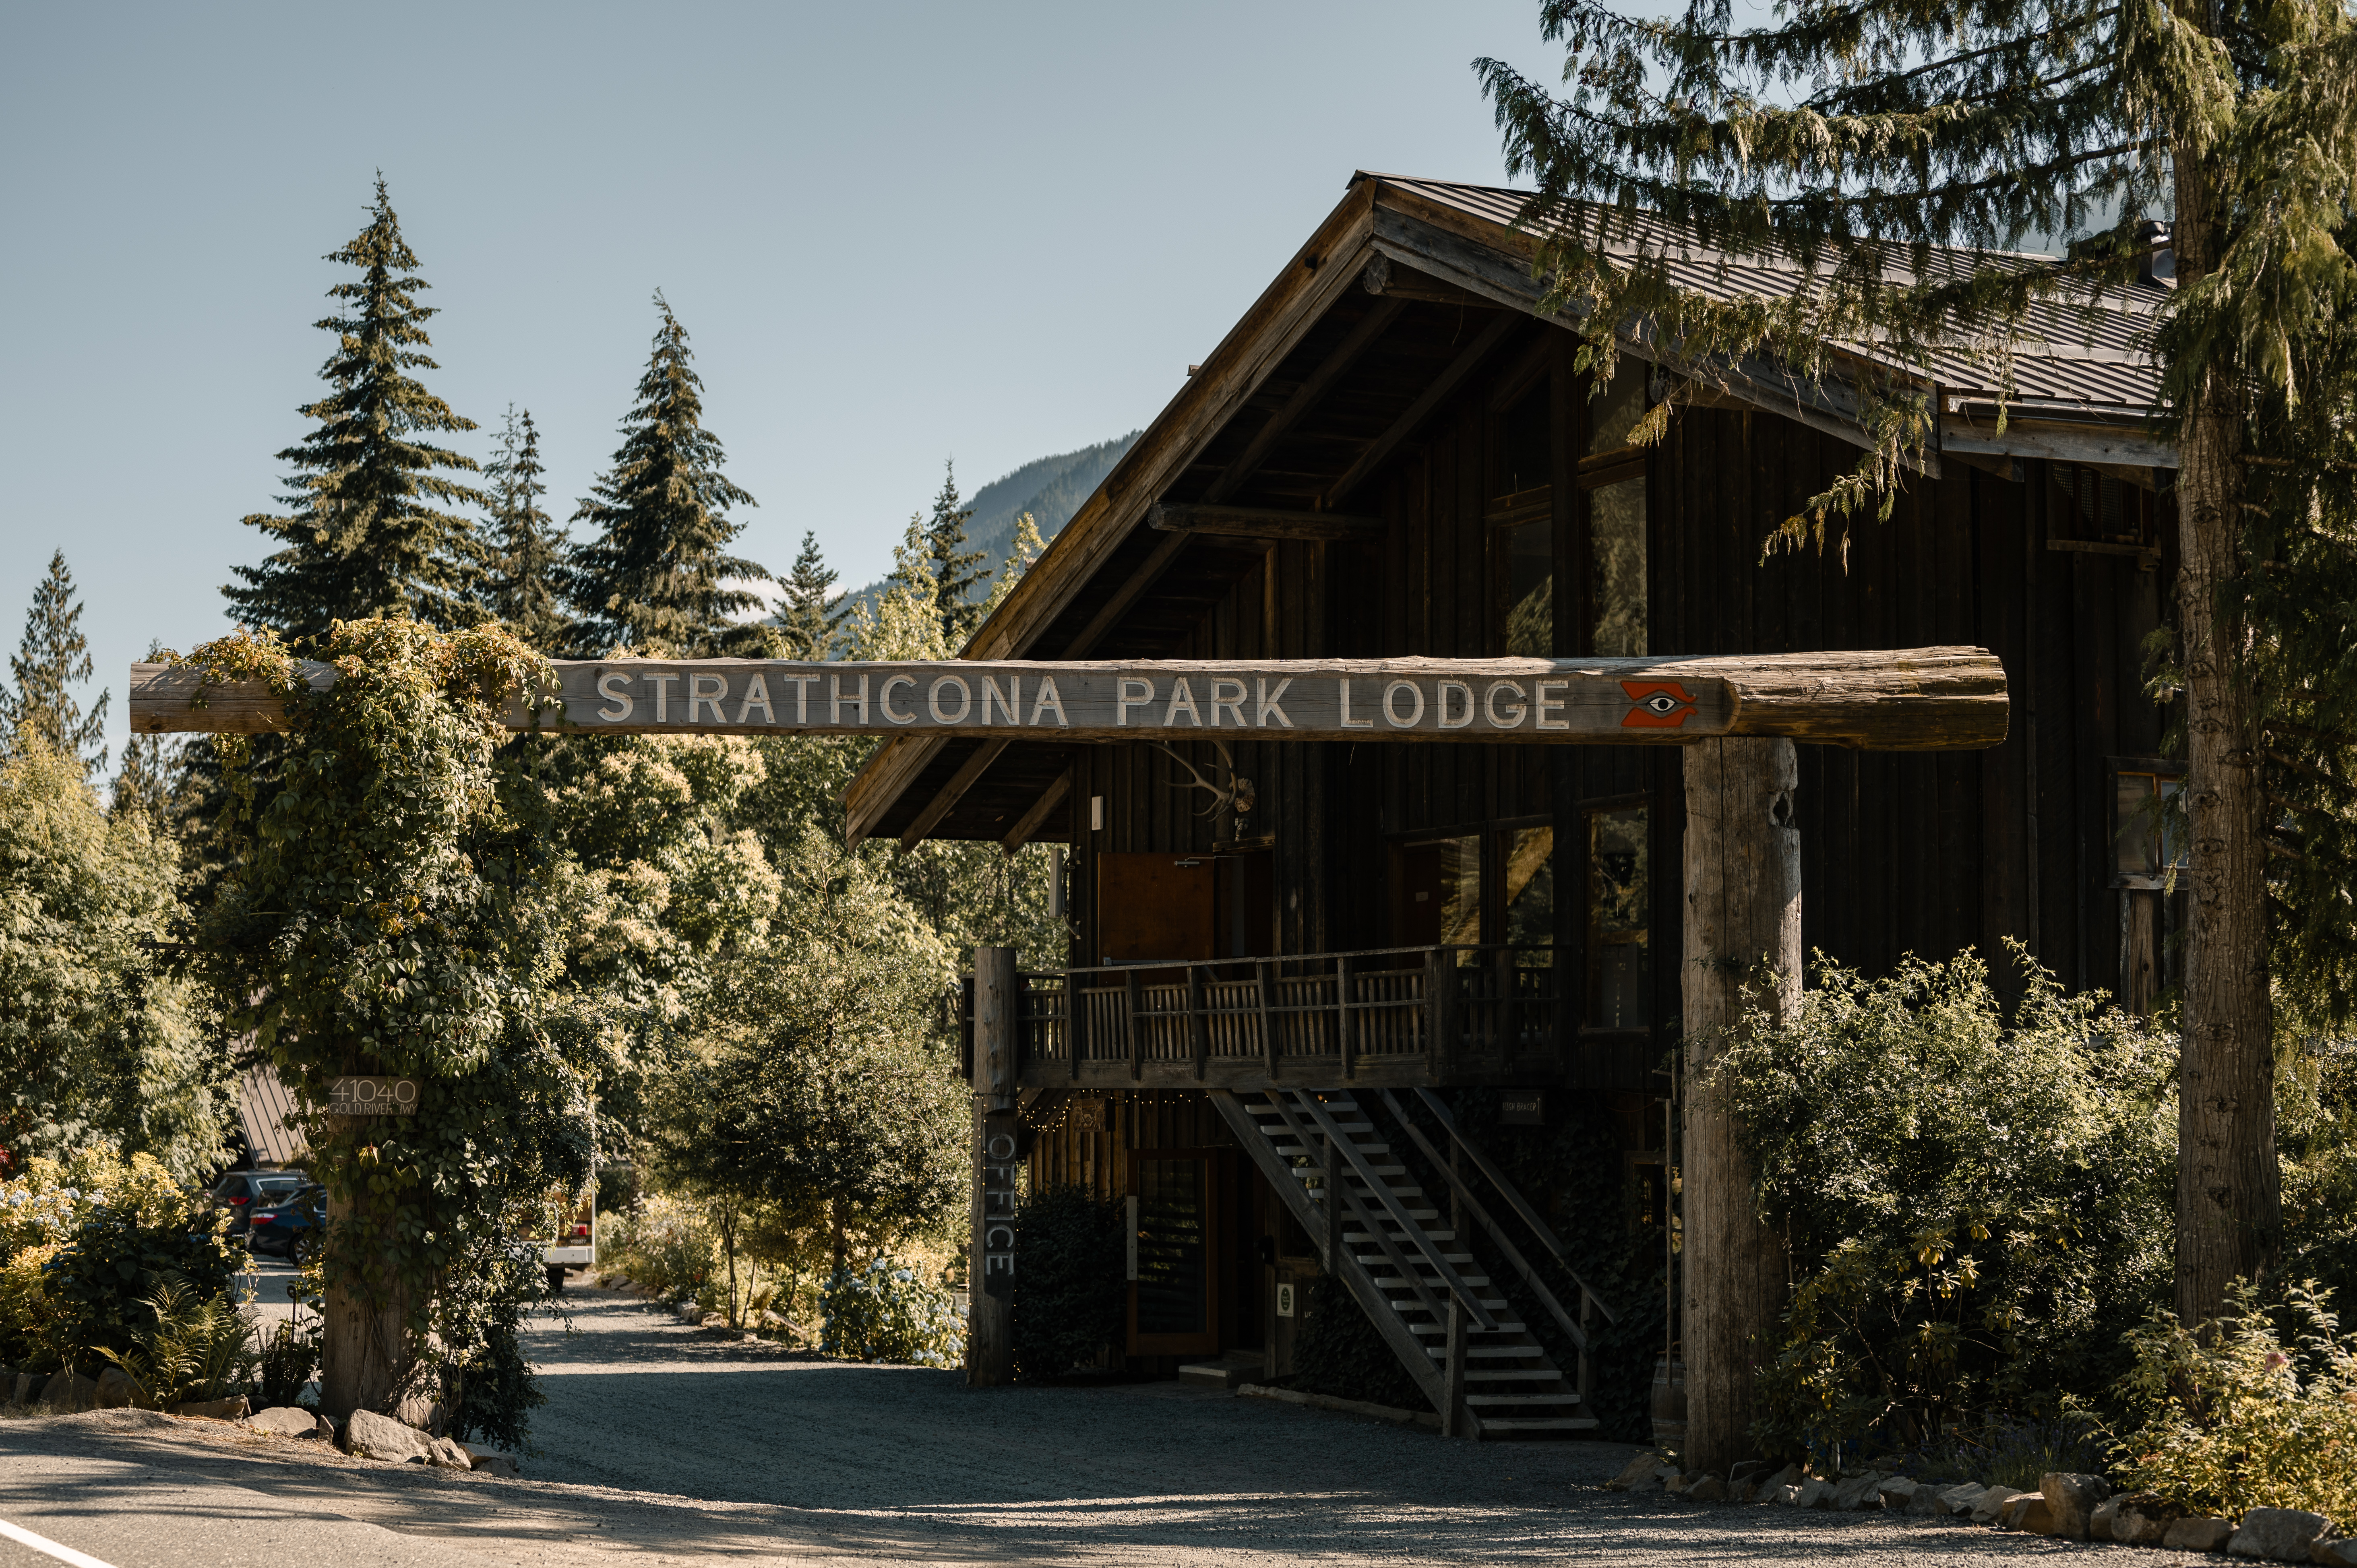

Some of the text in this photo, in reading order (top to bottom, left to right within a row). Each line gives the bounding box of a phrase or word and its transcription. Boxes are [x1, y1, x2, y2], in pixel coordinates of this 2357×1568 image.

[596, 671, 1569, 729] STRATHCONA PARK LODGE
[329, 1078, 416, 1103] 41040
[329, 1103, 362, 1114] GOLD
[364, 1103, 393, 1115] RIVER
[1502, 1102, 1515, 1111] HIGH
[986, 1134, 1015, 1275] OFFICE
